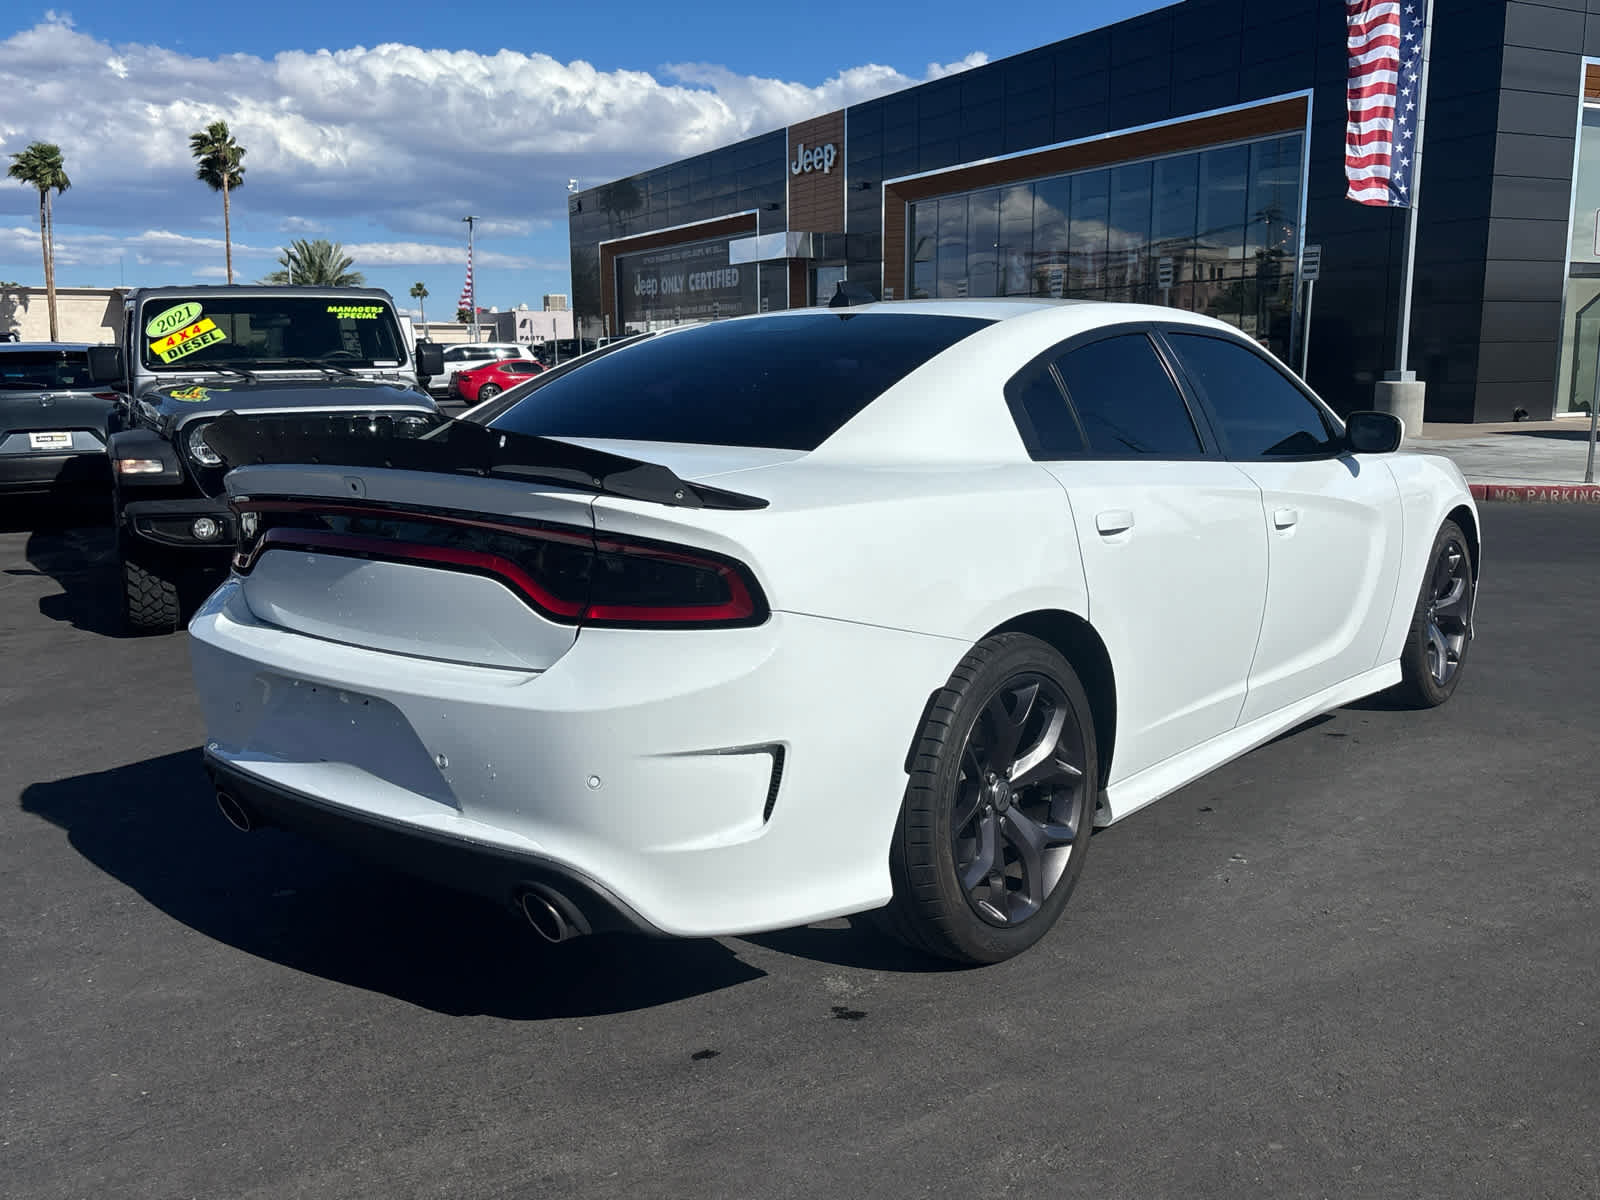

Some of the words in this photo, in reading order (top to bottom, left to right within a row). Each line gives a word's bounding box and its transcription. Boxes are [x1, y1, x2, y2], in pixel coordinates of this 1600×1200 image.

[791, 143, 836, 175] Jeep
[634, 273, 657, 298] Jeep
[661, 275, 684, 294] ONLY
[689, 268, 739, 291] CERTIFIED
[157, 306, 192, 333] 2021
[167, 332, 219, 359] DIESEL
[1495, 488, 1515, 500] NO
[1527, 489, 1600, 502] PARKING
